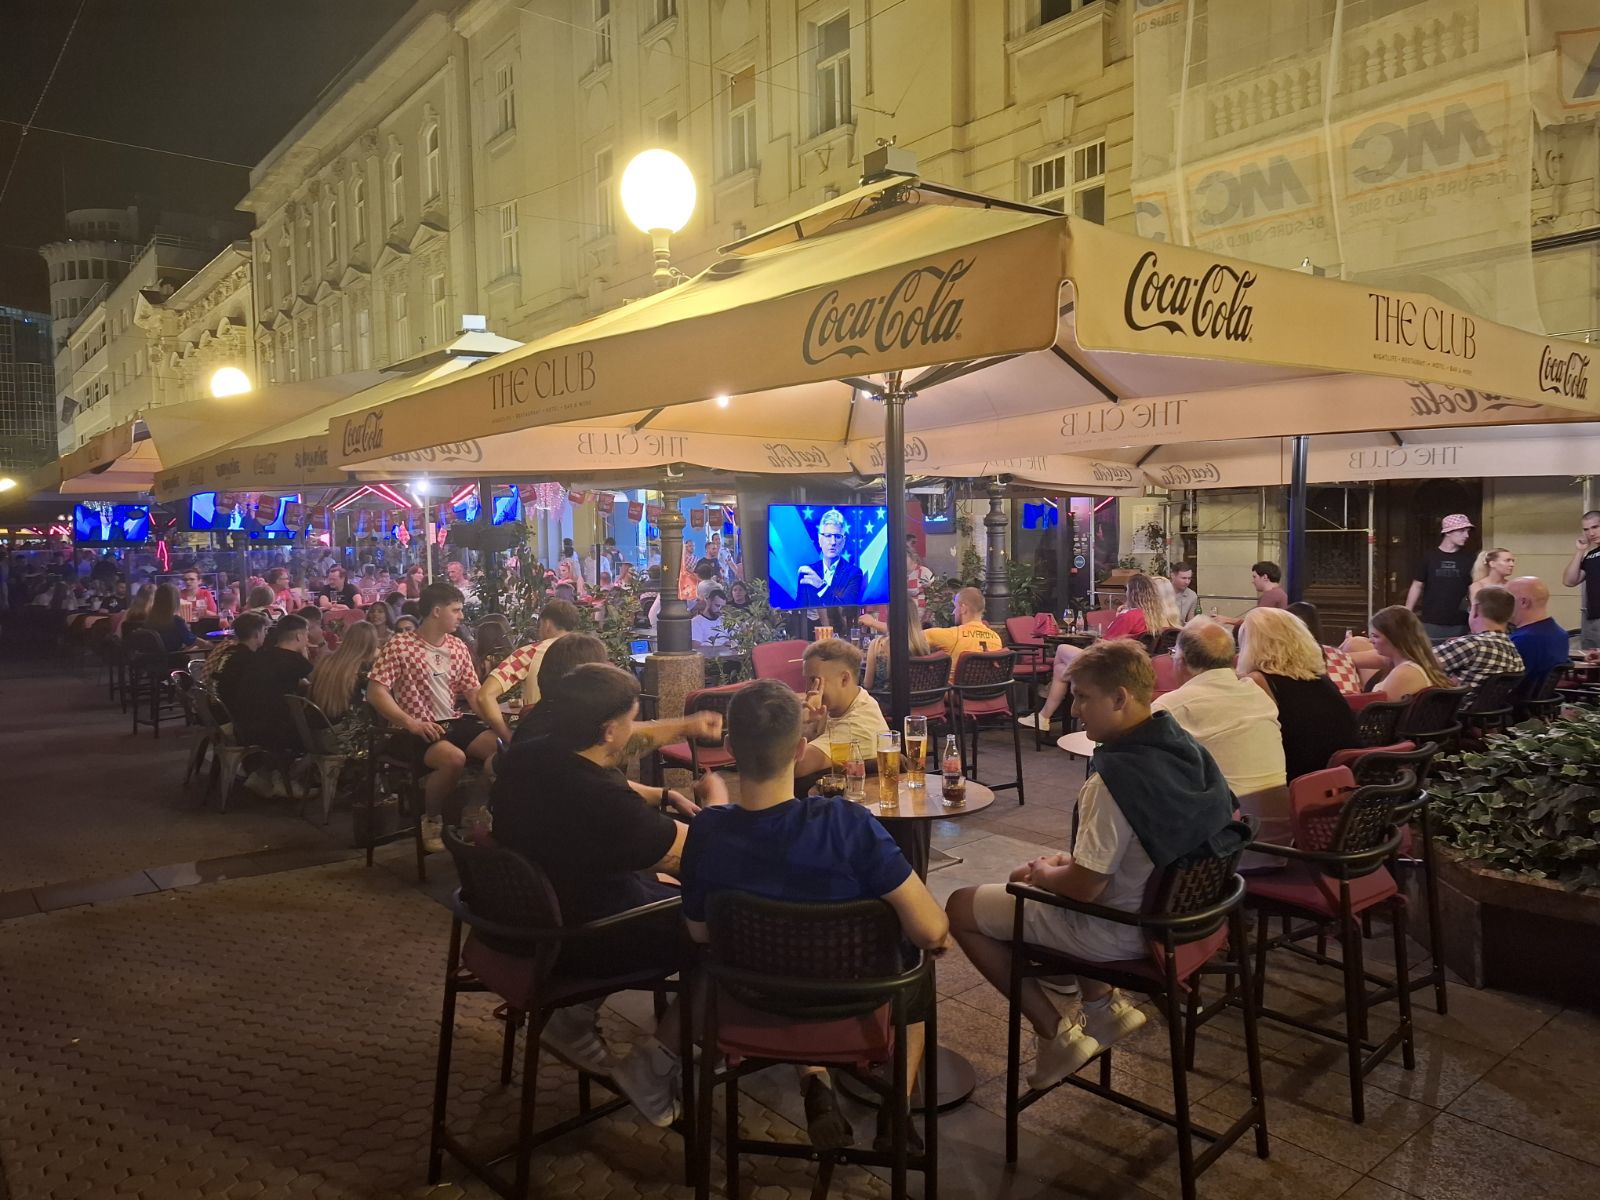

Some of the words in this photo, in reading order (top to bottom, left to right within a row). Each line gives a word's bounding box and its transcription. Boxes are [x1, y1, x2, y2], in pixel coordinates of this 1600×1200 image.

[803, 256, 976, 365] Coca-Cola
[1124, 251, 1257, 341] Coca-Cola
[1368, 293, 1418, 346] THE
[1423, 306, 1476, 359] CLUB
[488, 367, 529, 410] THE
[535, 350, 596, 399] CLUB
[1539, 345, 1590, 399] Coca-Cola
[343, 409, 383, 457] Coca-Cola
